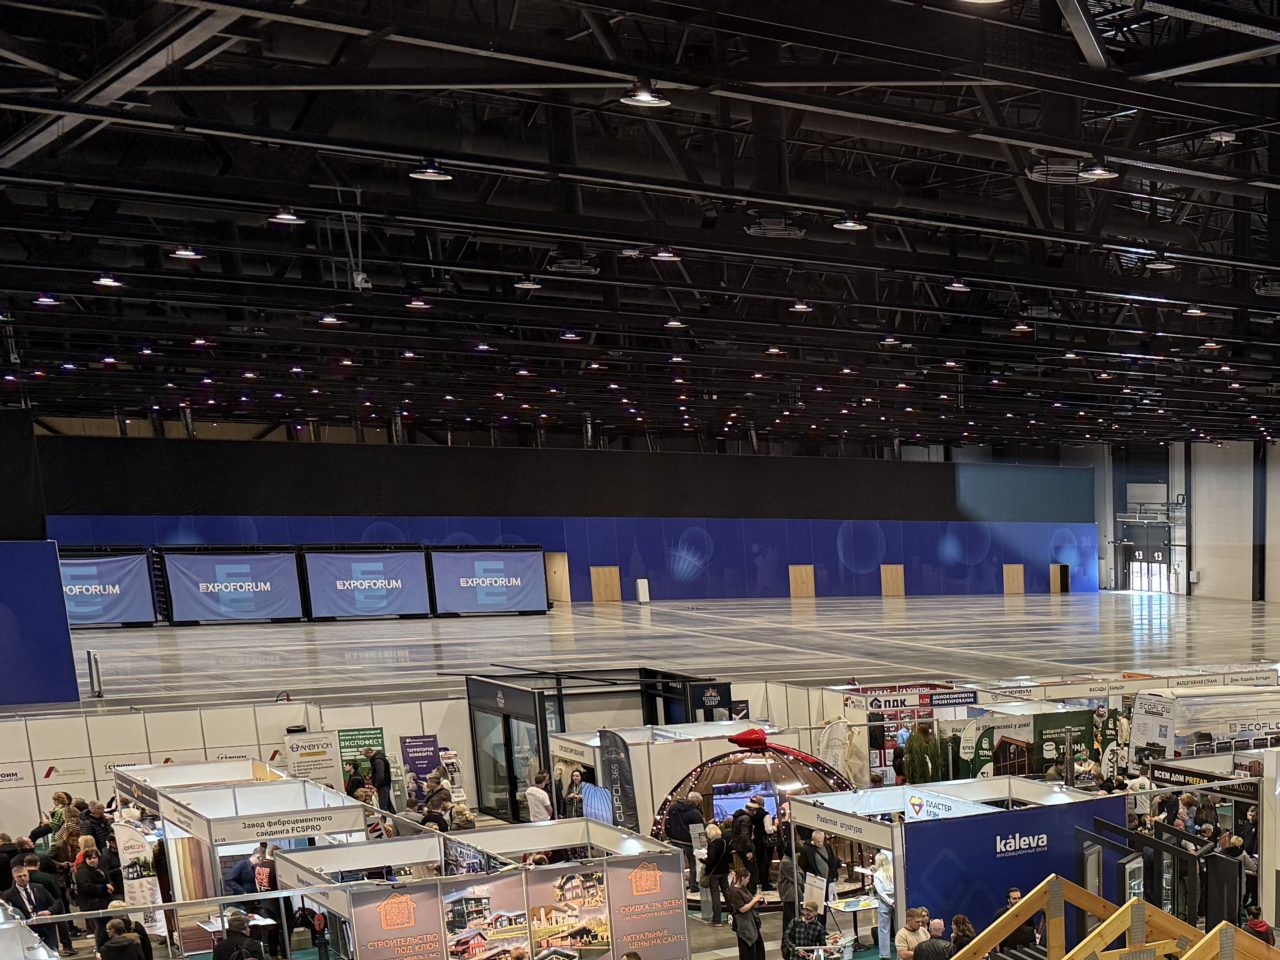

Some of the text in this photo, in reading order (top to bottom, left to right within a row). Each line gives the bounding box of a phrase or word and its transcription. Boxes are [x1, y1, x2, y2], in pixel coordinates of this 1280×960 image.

[1134, 550, 1143, 560] 13
[1154, 552, 1163, 561] 13
[199, 582, 271, 593] EXPOFORUM
[336, 579, 402, 590] EXPOFORUM
[460, 577, 521, 587] EXPOFORUM
[64, 584, 120, 595] OFORUM
[884, 698, 908, 708] ПДК
[1139, 702, 1171, 714] ECOFLOW
[1154, 770, 1170, 780] ВСЕМ
[1171, 773, 1185, 782] ДОМ
[242, 815, 333, 830] Завод фиброцементного
[255, 824, 322, 838] сайдинга FCSPRO
[620, 899, 683, 914] СКИДКА ВСЕМ
[368, 933, 439, 950] СТРОИТЕЛЬСТВО
[622, 929, 669, 942] АКТУАЛЬНЫЕ
[628, 933, 686, 949] ЦЕНЫ НА САЙТЕ
[395, 941, 440, 955] ПОД КЛЮЧ
